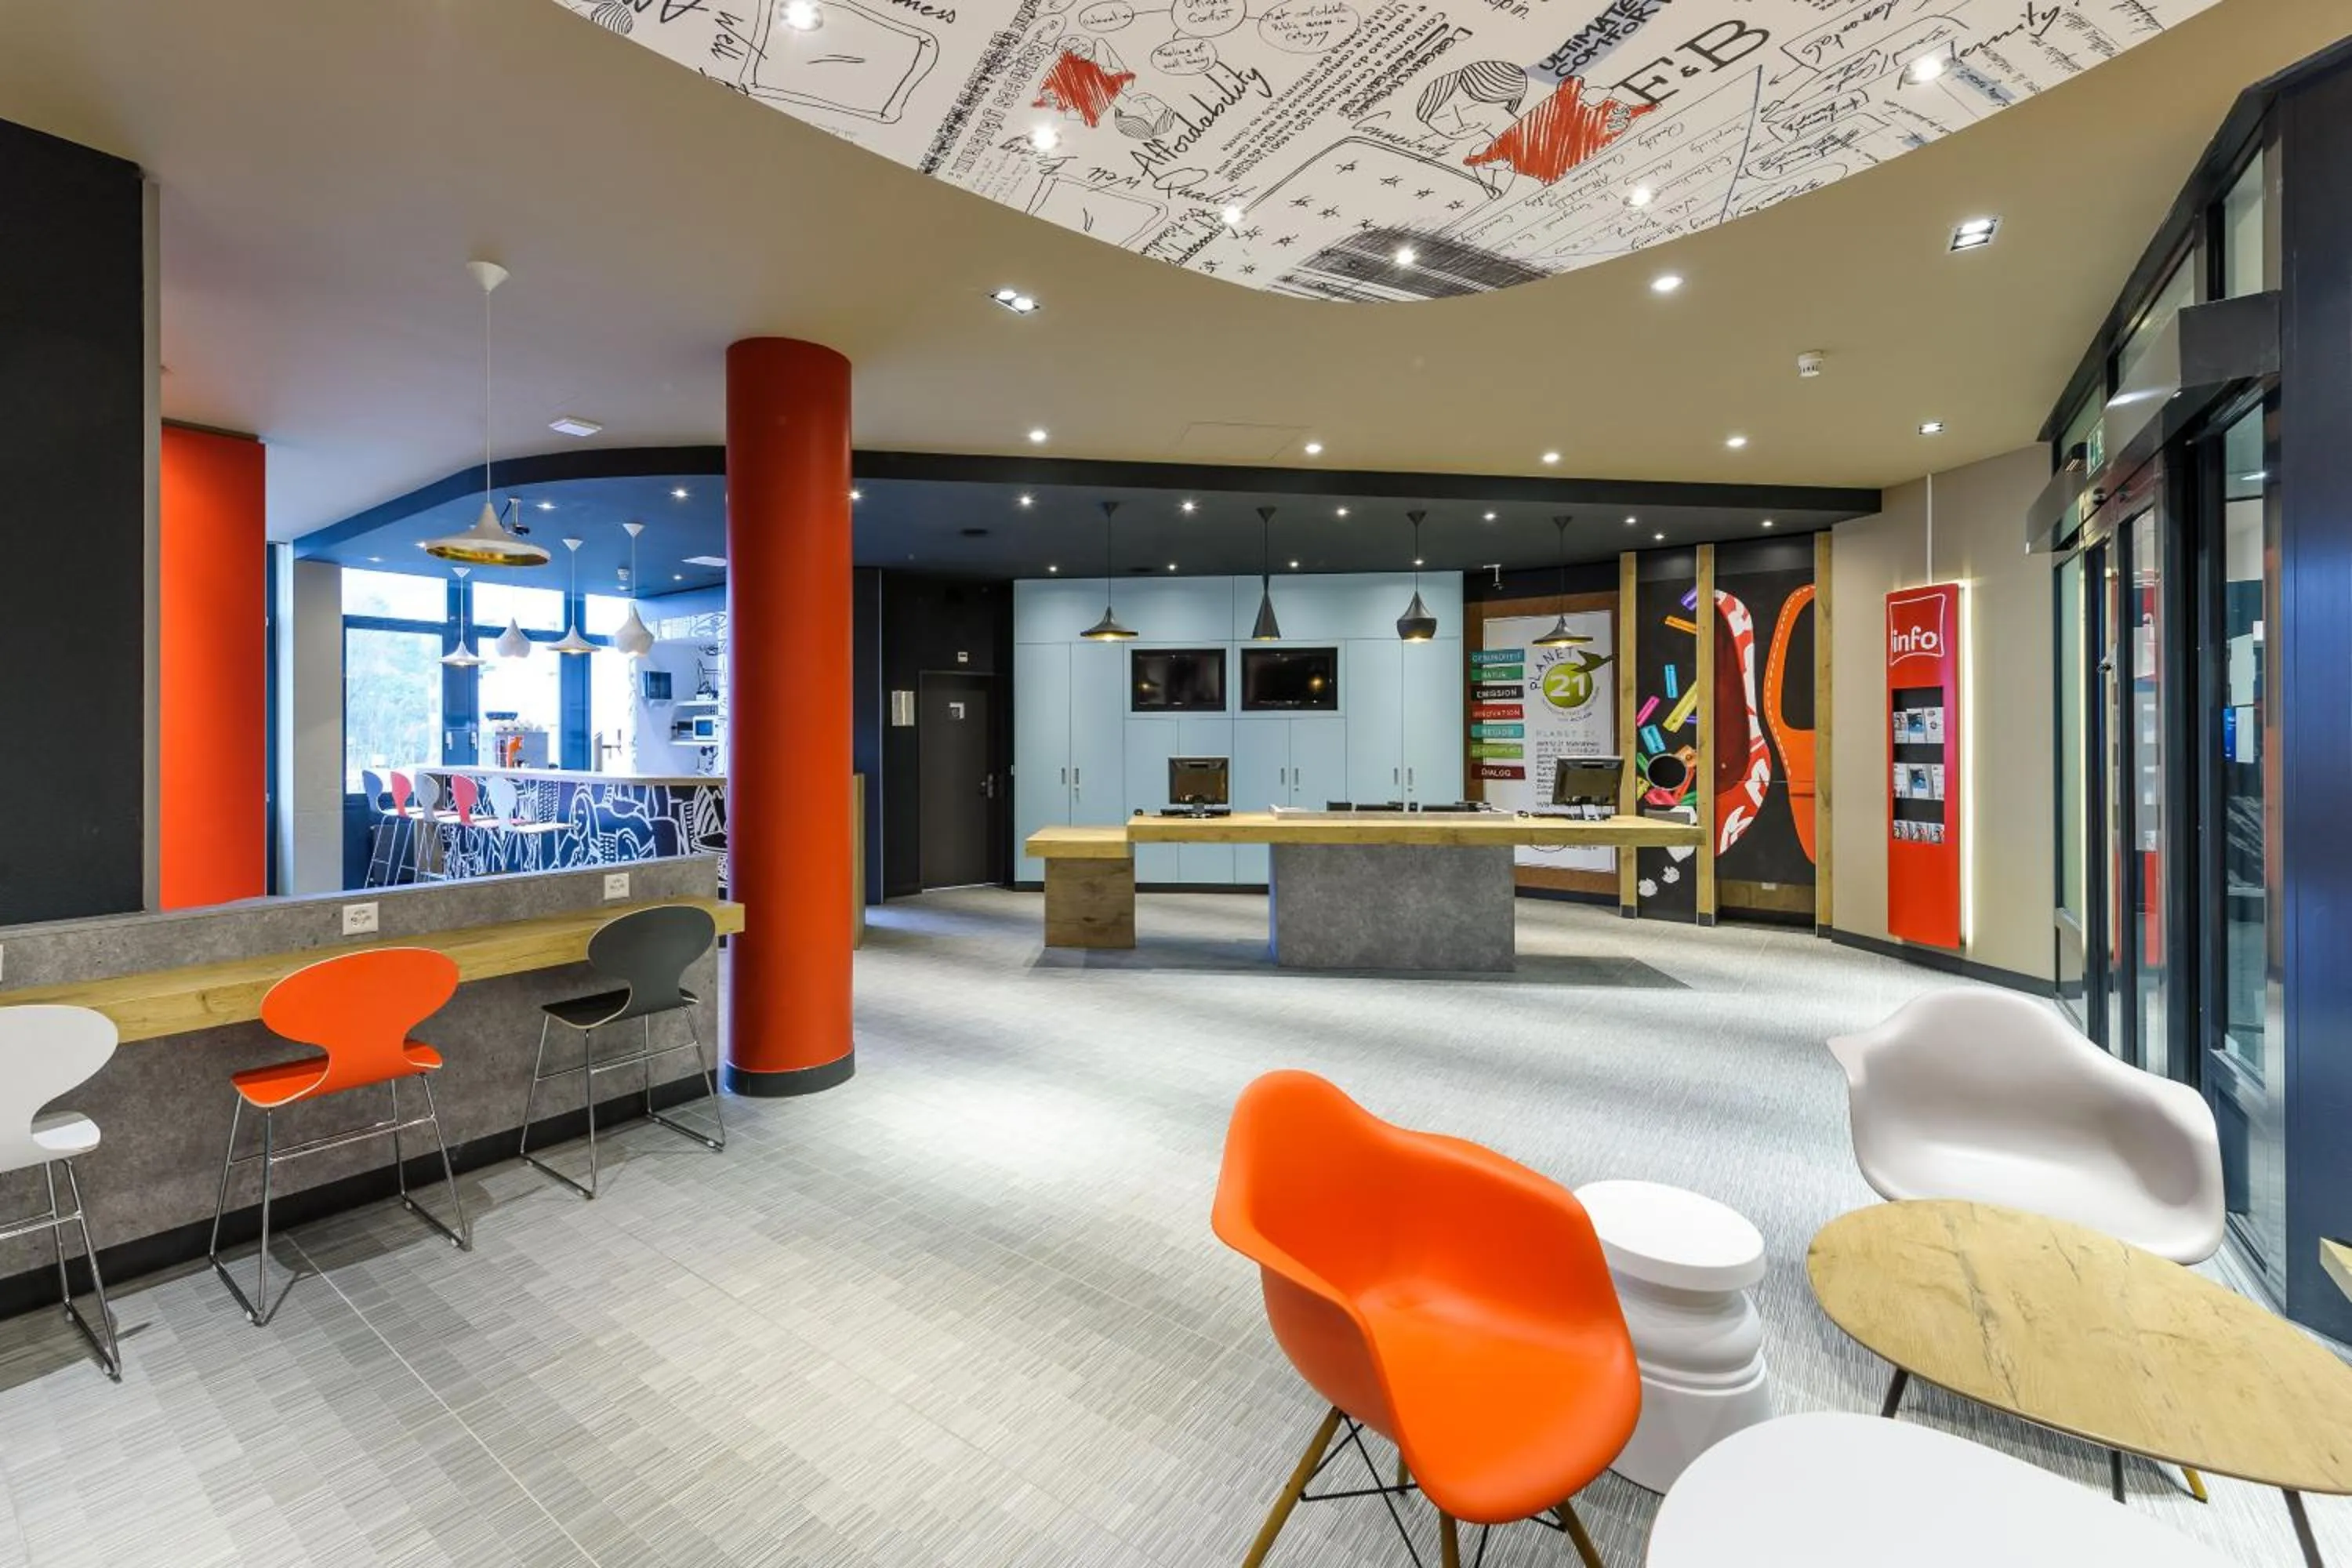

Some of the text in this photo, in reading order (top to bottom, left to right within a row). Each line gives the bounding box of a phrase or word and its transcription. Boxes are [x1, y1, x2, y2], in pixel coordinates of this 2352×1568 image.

[1538, 0, 1637, 70] ULTIMATE
[1555, 0, 1671, 77] COMFOR
[1133, 67, 1273, 178] Affordability
[1893, 625, 1938, 652] info
[1550, 673, 1586, 697] 21
